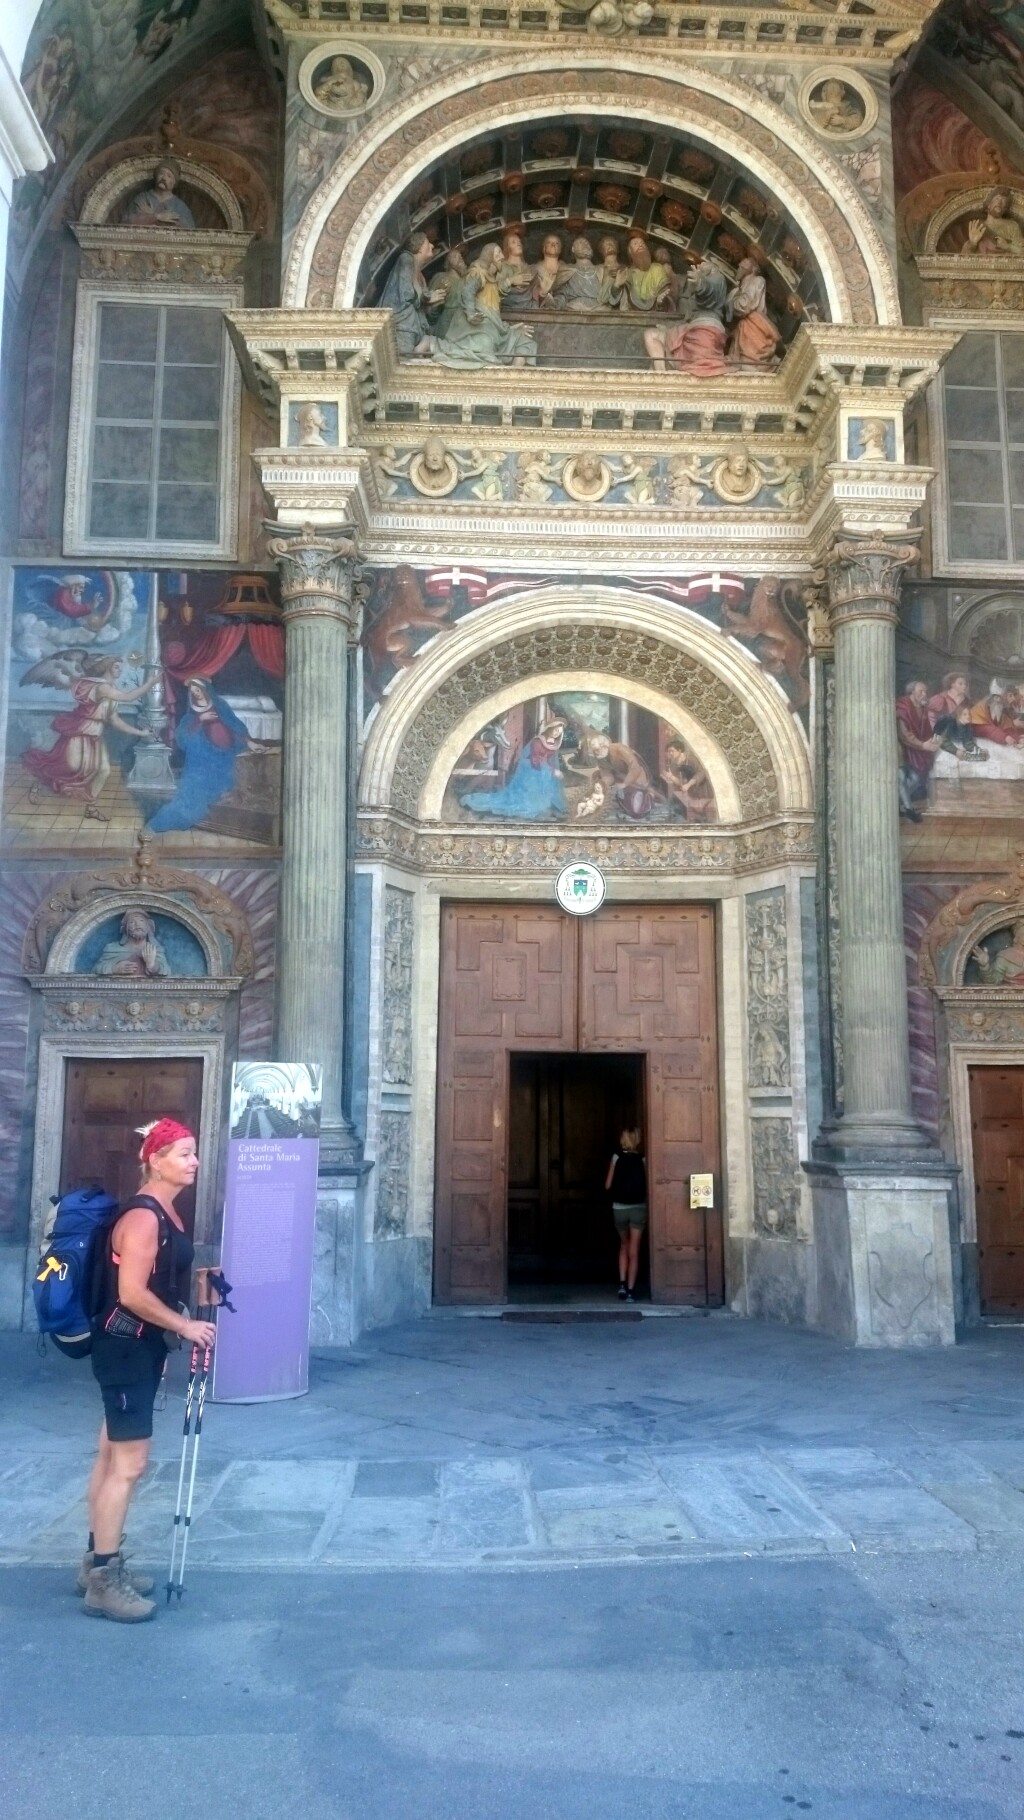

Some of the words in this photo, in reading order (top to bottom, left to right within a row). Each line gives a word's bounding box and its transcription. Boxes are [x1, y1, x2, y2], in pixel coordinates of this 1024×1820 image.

[238, 1143, 283, 1153] Cattedrale
[238, 1153, 247, 1162] di
[249, 1153, 273, 1162] Santa
[276, 1153, 301, 1162] Maria
[237, 1163, 272, 1171] Assunta
